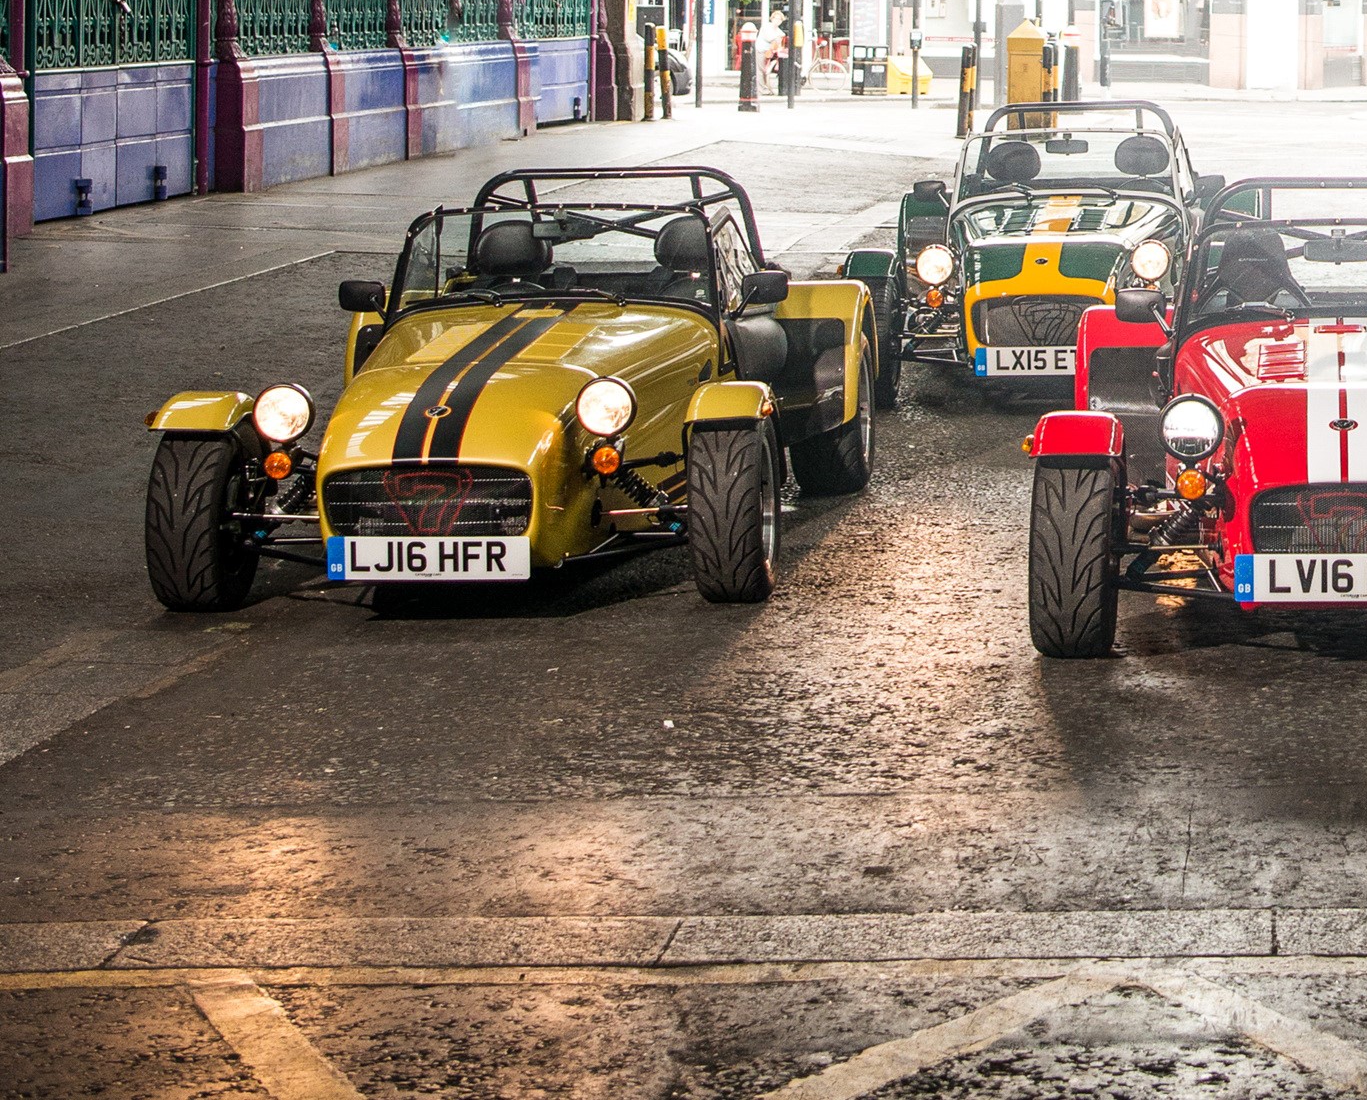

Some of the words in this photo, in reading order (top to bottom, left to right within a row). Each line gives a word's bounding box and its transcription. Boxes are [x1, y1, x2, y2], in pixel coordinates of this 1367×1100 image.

[996, 349, 1047, 371] LX15
[1054, 349, 1077, 370] ET
[350, 541, 427, 572] LJ16
[438, 541, 507, 572] HFR
[330, 563, 343, 573] GB
[1268, 559, 1354, 594] LV16
[1237, 583, 1251, 594] GB
